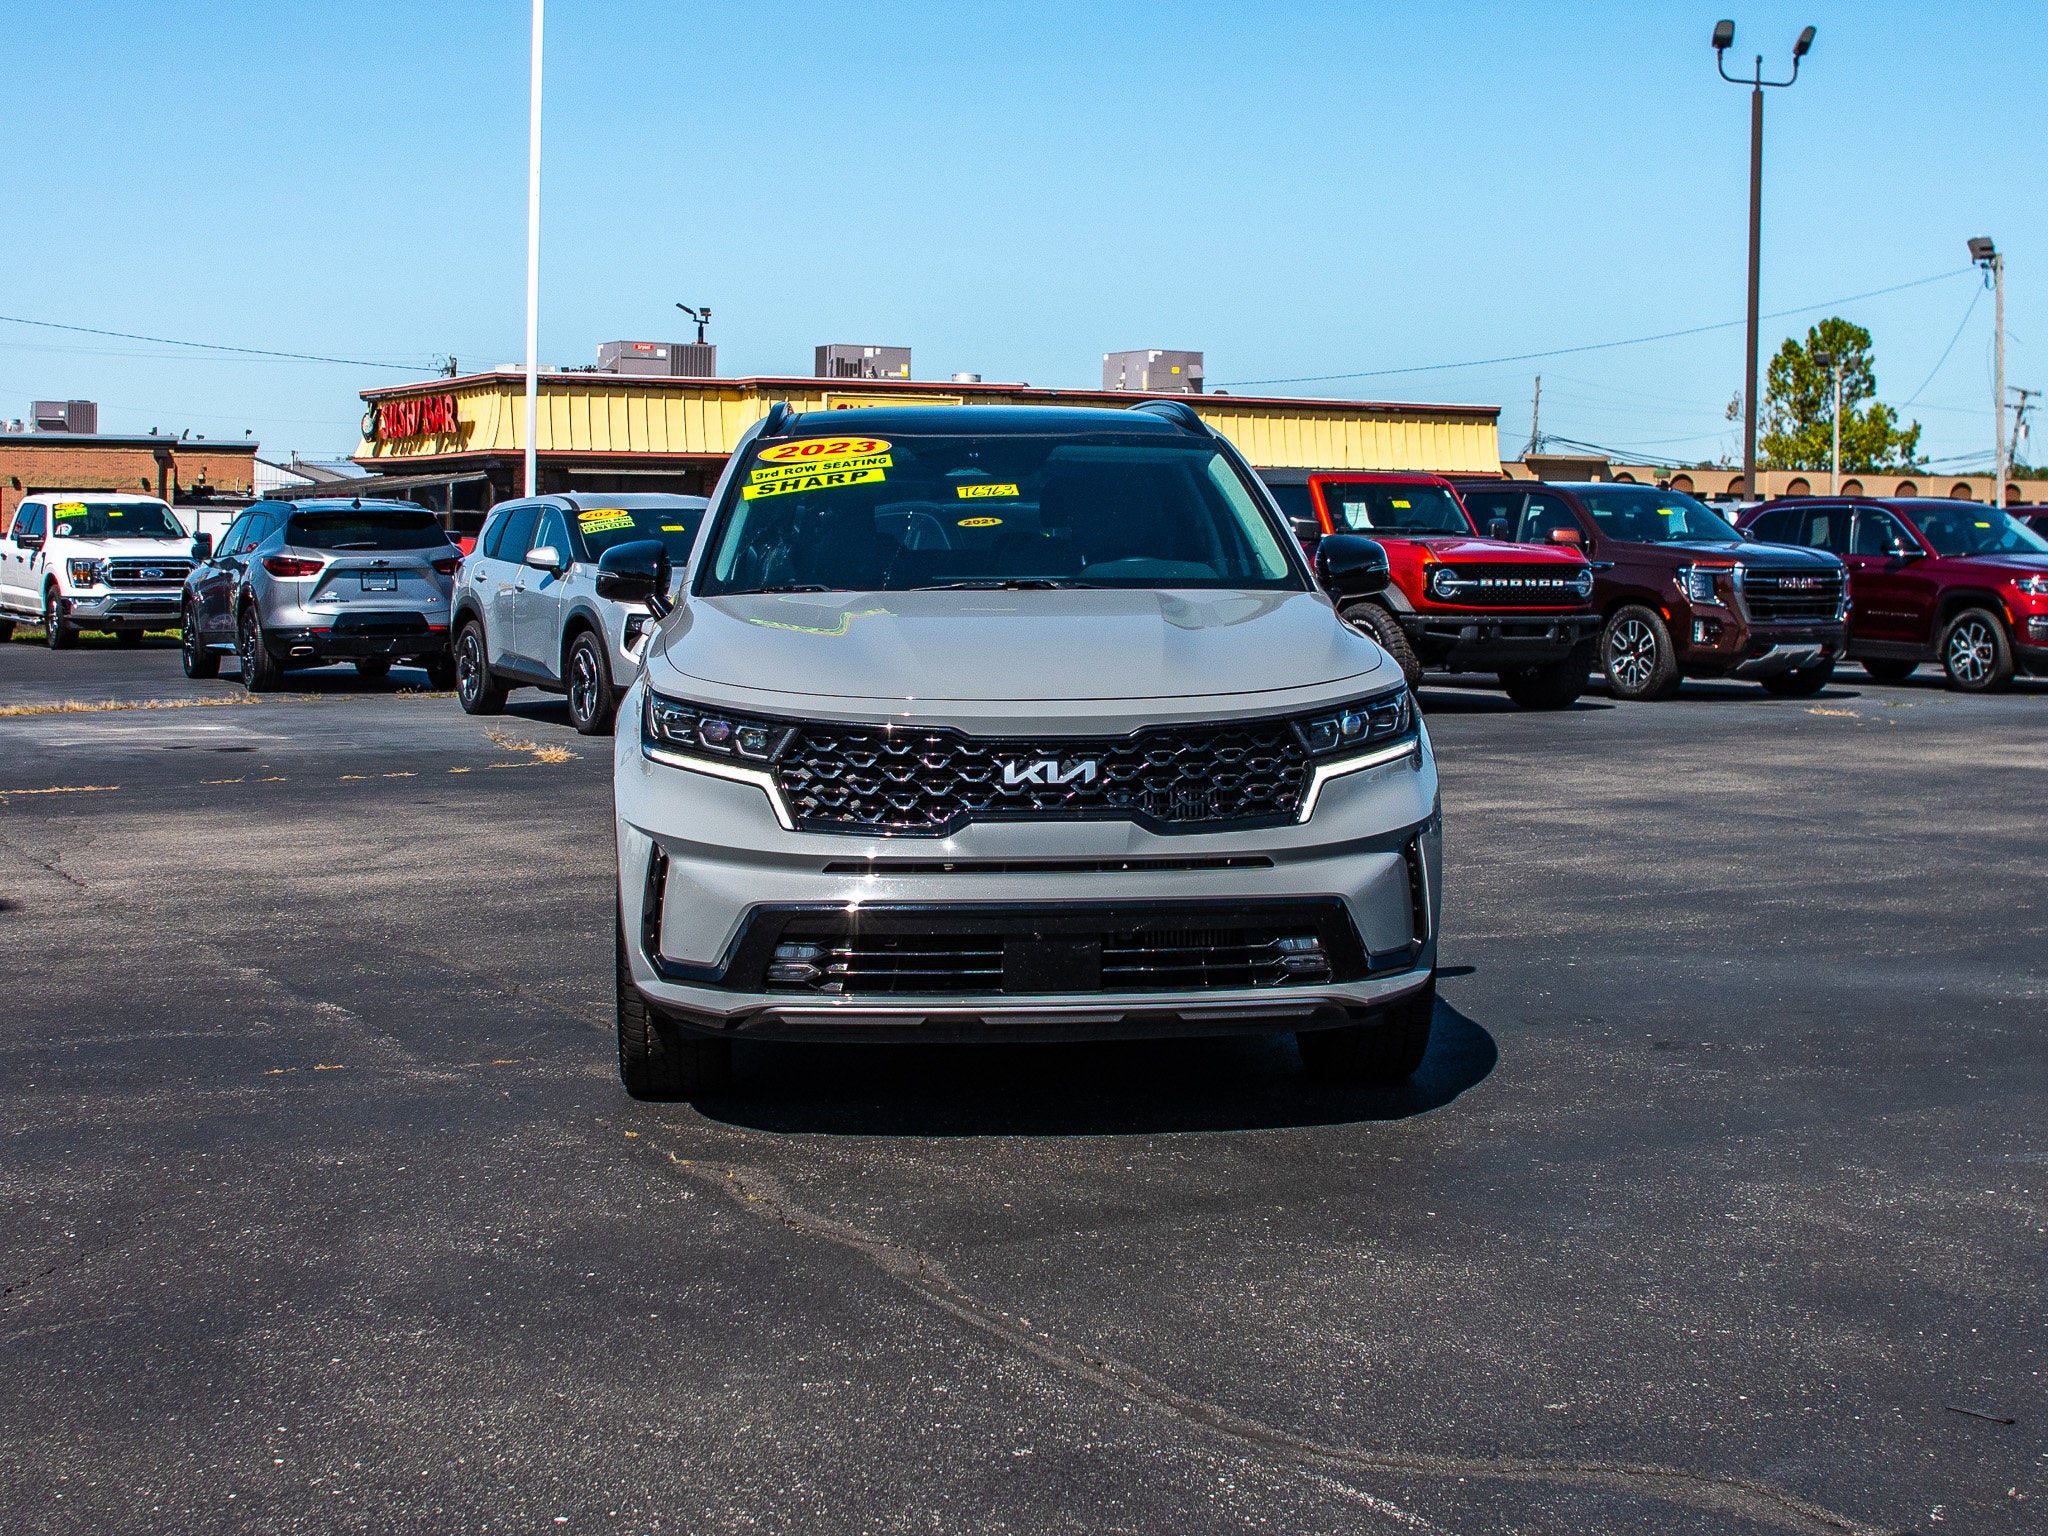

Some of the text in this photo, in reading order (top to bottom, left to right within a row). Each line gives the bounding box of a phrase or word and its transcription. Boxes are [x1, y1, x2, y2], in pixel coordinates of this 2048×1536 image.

[380, 395, 457, 440] SUSHI BAR
[774, 441, 877, 459] 2023
[755, 457, 887, 480] 3rd ROW SEATING
[756, 470, 869, 496] SHARP
[585, 510, 622, 519] 2024
[609, 521, 633, 529] CLEAN
[1480, 579, 1564, 587] BRONCO
[1004, 760, 1096, 784] KIA
